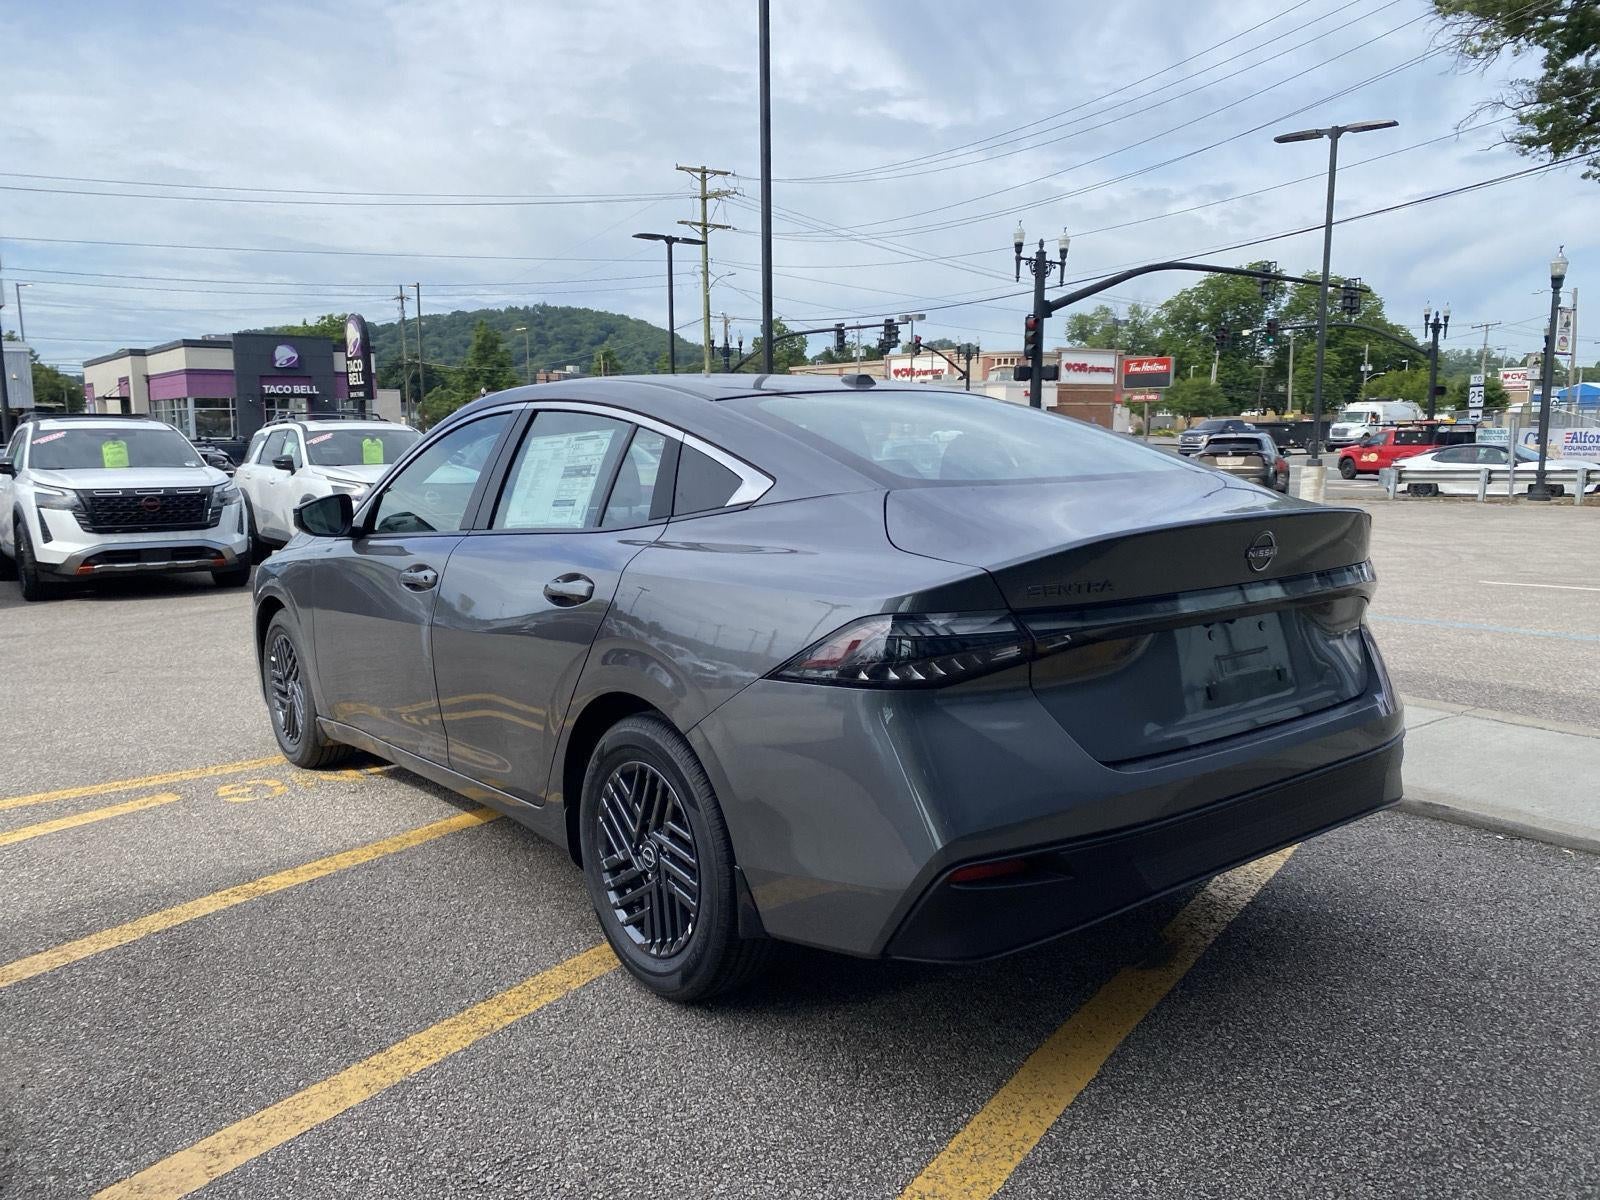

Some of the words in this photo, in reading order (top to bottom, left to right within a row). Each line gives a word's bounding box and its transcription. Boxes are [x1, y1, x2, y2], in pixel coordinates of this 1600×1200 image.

[347, 360, 362, 373] TACO
[1072, 363, 1087, 372] CVS
[1088, 365, 1114, 374] pharmacy
[1129, 363, 1141, 373] Tim
[1141, 361, 1167, 372] Hortons
[348, 372, 364, 386] BELL
[901, 368, 915, 377] CVS
[916, 368, 945, 378] pharmacy
[1511, 372, 1528, 380] CVS
[262, 384, 292, 394] TACO
[293, 385, 320, 395] BELL
[1470, 391, 1484, 404] 25
[1024, 579, 1115, 598] SENTRA
